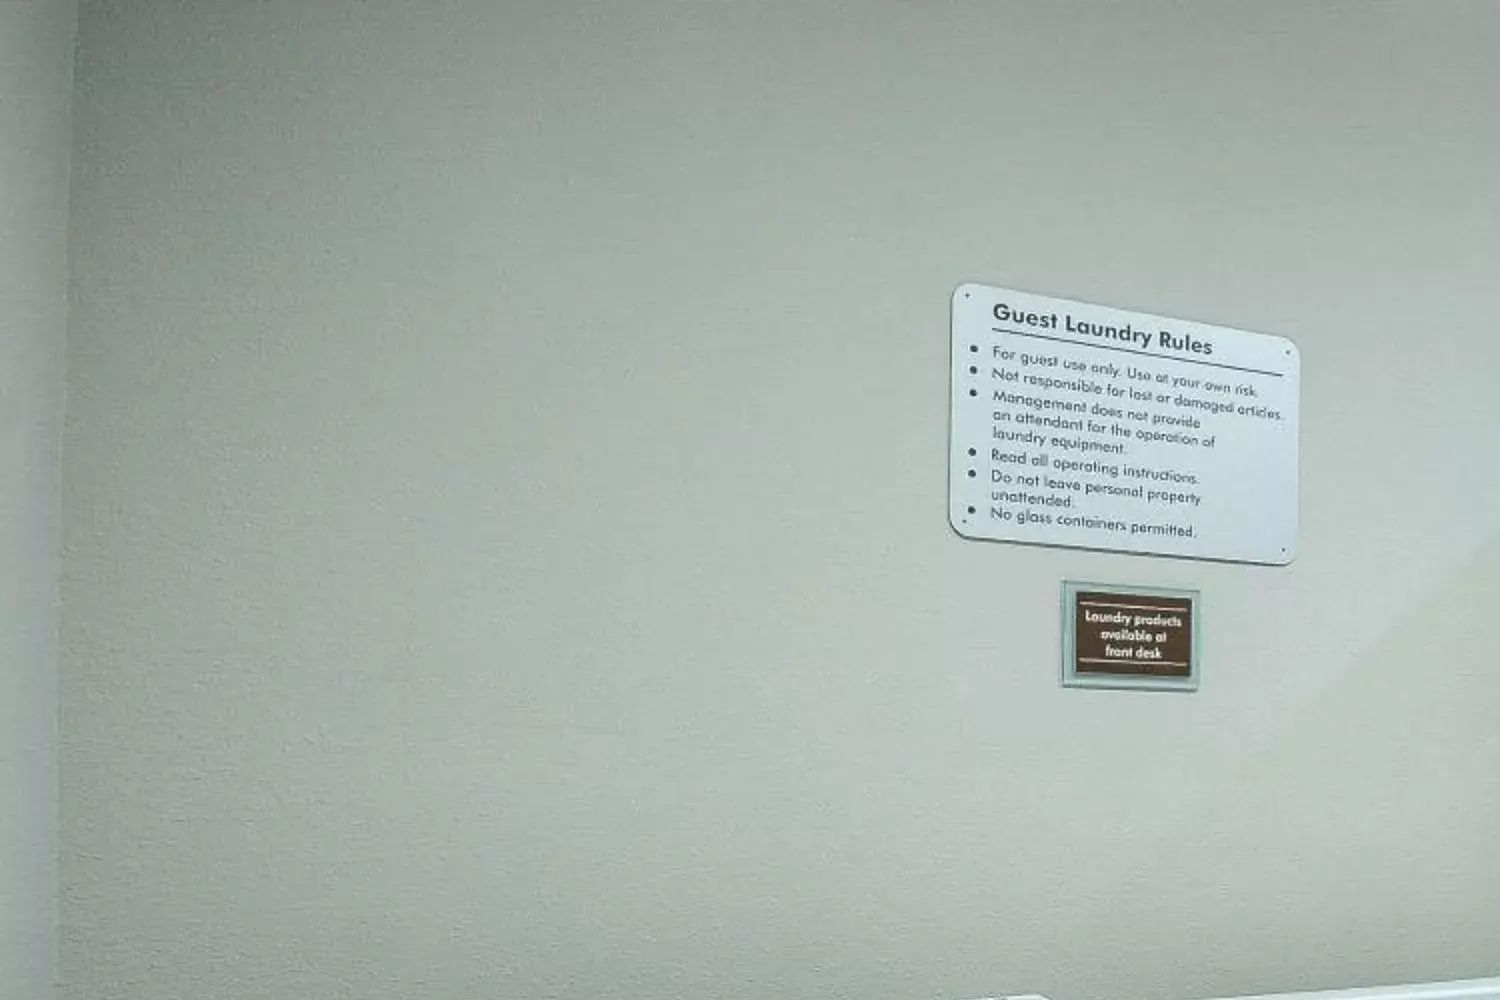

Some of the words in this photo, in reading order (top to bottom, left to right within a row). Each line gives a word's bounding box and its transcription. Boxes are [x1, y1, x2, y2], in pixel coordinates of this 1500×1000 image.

[992, 303, 1058, 329] Guest
[1066, 315, 1152, 348] Laundry
[1159, 326, 1213, 355] Rules
[993, 346, 1016, 360] For
[1020, 353, 1058, 366] guest
[1063, 359, 1086, 371] use
[1091, 362, 1121, 378] only.
[1127, 367, 1150, 381] Use
[1156, 373, 1168, 384] at
[1172, 376, 1199, 389] your
[1204, 381, 1231, 393] own
[992, 367, 1019, 381] Not
[1024, 374, 1102, 395] responsible
[1107, 384, 1124, 397] for
[1129, 387, 1152, 401] lost
[1156, 394, 1170, 404] or
[1174, 393, 1234, 414] damaged
[992, 391, 1087, 413] Management
[1091, 403, 1122, 418] does
[1127, 410, 1148, 421] not
[1153, 413, 1201, 429] provide
[993, 411, 1011, 421] an
[1015, 413, 1083, 431] attendant
[1087, 420, 1106, 433] for
[1111, 423, 1131, 437] the
[1136, 429, 1198, 447] operation
[1202, 436, 1216, 448] of
[993, 426, 1046, 447] laundry
[991, 448, 1026, 464] Read
[1032, 454, 1048, 466] all
[1053, 459, 1118, 478] operating
[992, 469, 1012, 483] Do
[1017, 475, 1039, 486] not
[1044, 476, 1080, 491] leave
[1085, 483, 1143, 499] personal
[991, 506, 1012, 520] No
[1017, 509, 1052, 525] glass
[1057, 515, 1126, 531] containers
[1085, 610, 1132, 626] Laundry
[1134, 614, 1182, 627] products
[1100, 629, 1152, 643] available
[1156, 632, 1167, 643] at
[1105, 644, 1133, 657] front
[1136, 645, 1162, 659] desk
